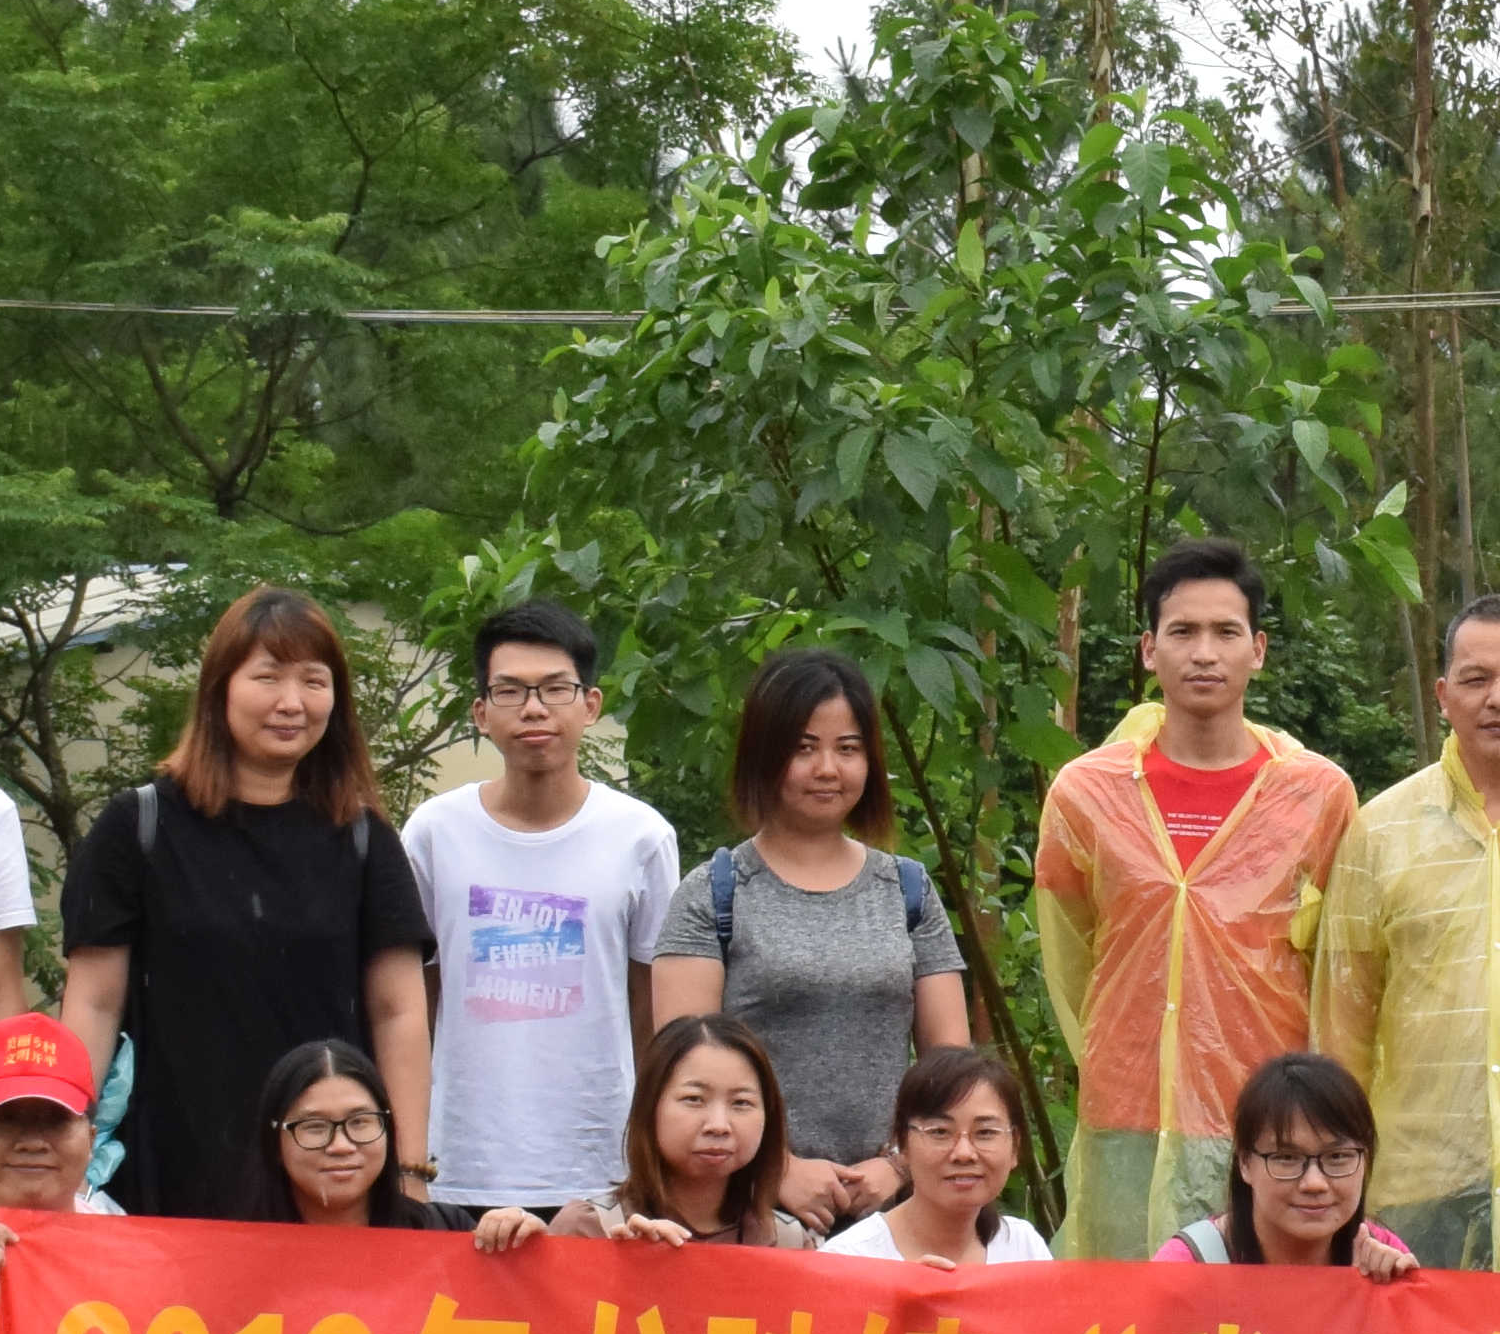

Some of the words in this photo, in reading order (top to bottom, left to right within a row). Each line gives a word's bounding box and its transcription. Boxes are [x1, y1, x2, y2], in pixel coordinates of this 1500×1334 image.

[492, 891, 569, 933] ENJOY
[489, 937, 560, 970] EVERY
[475, 974, 572, 1012] MOMENT
